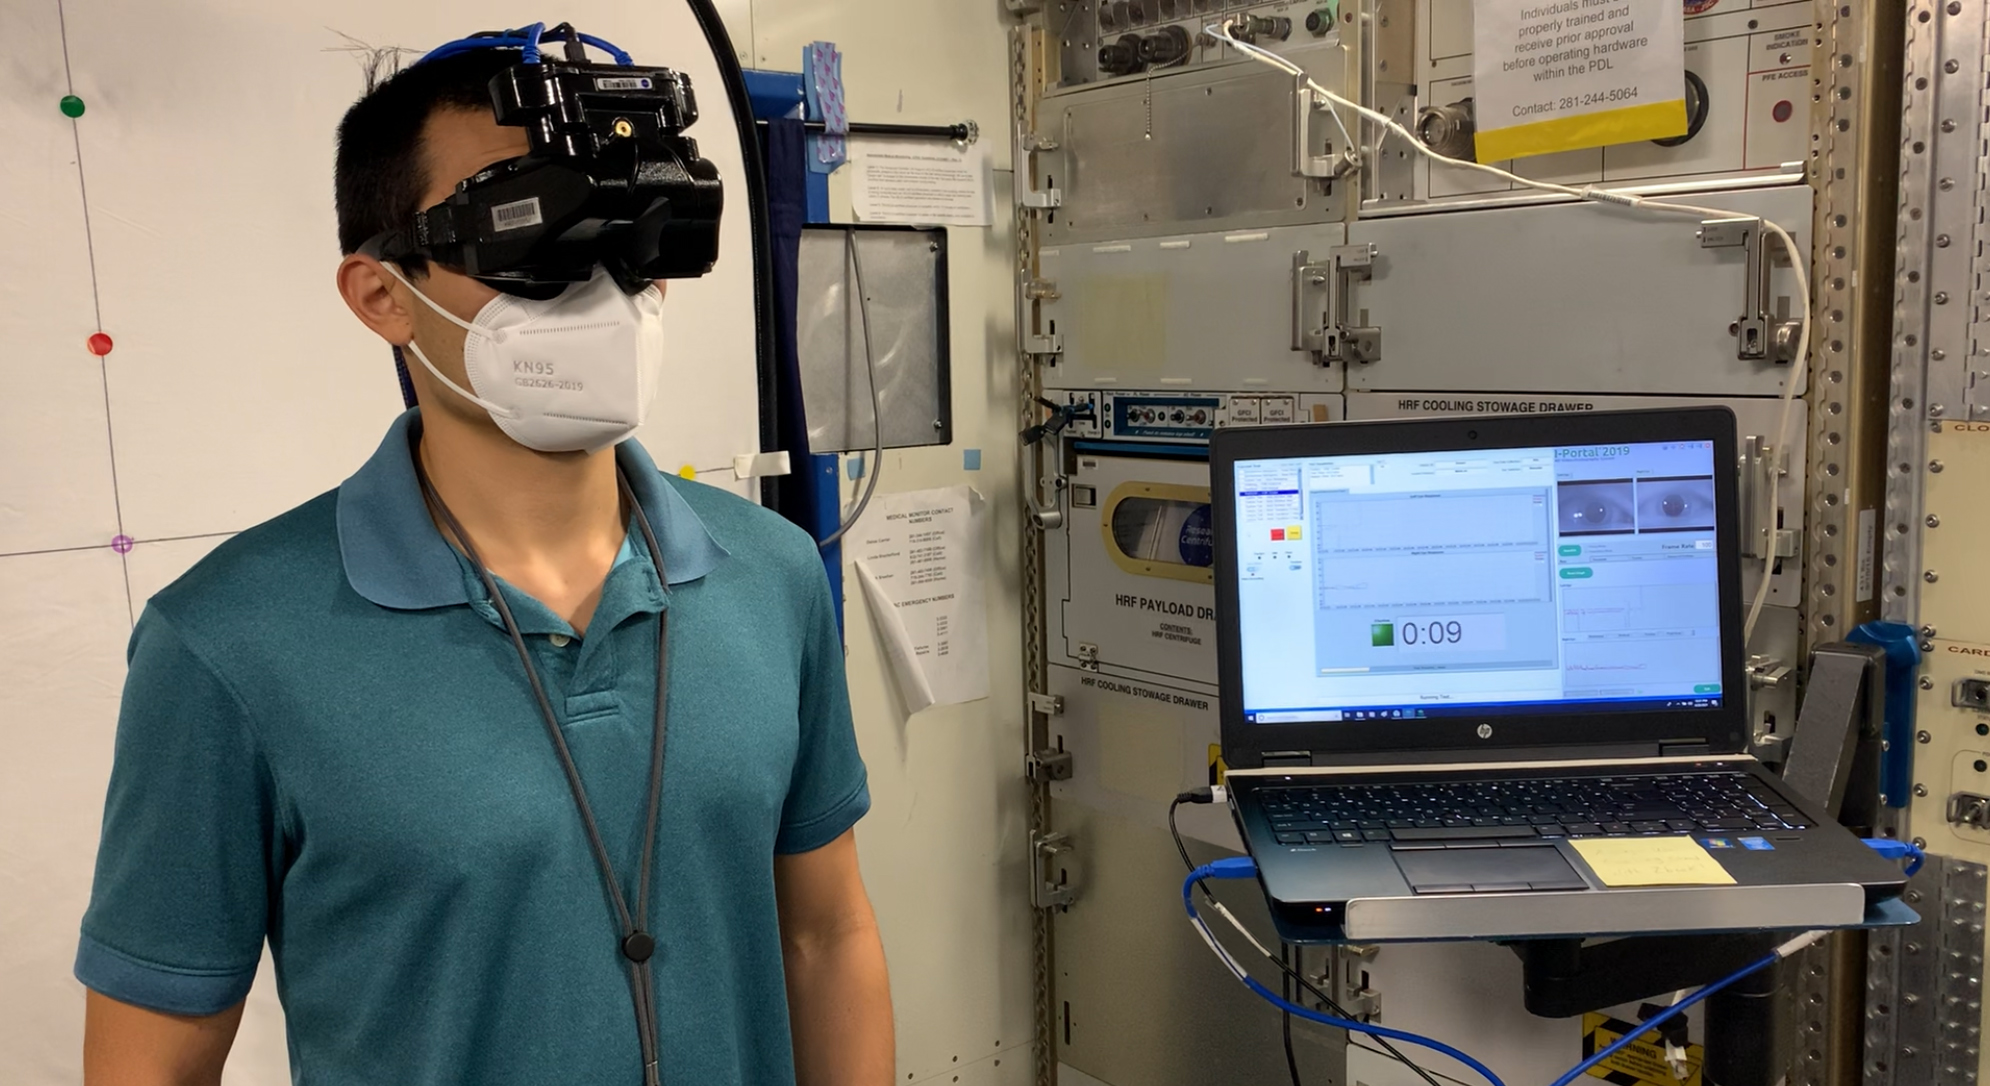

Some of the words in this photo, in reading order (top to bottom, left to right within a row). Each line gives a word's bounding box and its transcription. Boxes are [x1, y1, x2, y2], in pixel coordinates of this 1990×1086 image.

[1520, 0, 1579, 21] Individuals
[1518, 17, 1564, 39] properly
[1566, 11, 1604, 28] trained
[1608, 5, 1630, 20] and
[1514, 36, 1553, 54] receive
[1556, 31, 1581, 48] prior
[1584, 21, 1634, 42] approval
[1774, 30, 1800, 40] SMOKE
[1766, 38, 1808, 50] INDICATION
[1502, 56, 1536, 72] before
[1538, 46, 1590, 65] operating
[1593, 36, 1648, 54] hardware
[1533, 66, 1565, 82] within
[1568, 61, 1586, 76] the
[1588, 58, 1614, 72] PDL
[1762, 73, 1776, 82] PFE
[1778, 70, 1808, 80] ACCESS
[1512, 101, 1556, 118] Contact:
[1559, 86, 1638, 110] 281-244-5064
[513, 360, 554, 376] KN95
[1398, 400, 1420, 410] HRF
[1422, 400, 1474, 412] COOLING
[1476, 401, 1536, 412] STOWAGE
[1538, 402, 1594, 412] DRAWER
[1231, 416, 1258, 424] Protected
[1264, 415, 1291, 423] Protected
[1602, 446, 1630, 456] 2019
[908, 510, 930, 518] MONITOR
[931, 508, 954, 516] CONTACT
[902, 598, 931, 607] EMERGENCY
[932, 594, 954, 602] NUMBERS
[1116, 594, 1137, 608] HRF
[1140, 598, 1194, 616] PAYLOAD
[1198, 606, 1216, 620] DR
[1160, 622, 1193, 635] CONTENTS:
[1402, 620, 1462, 646] 0:09
[1165, 632, 1202, 645] CENTRIFUGE
[1081, 676, 1096, 686] HRF
[1098, 680, 1131, 694] COOLING
[1133, 687, 1171, 702] STOWAGE
[1173, 695, 1208, 710] DRAWER
